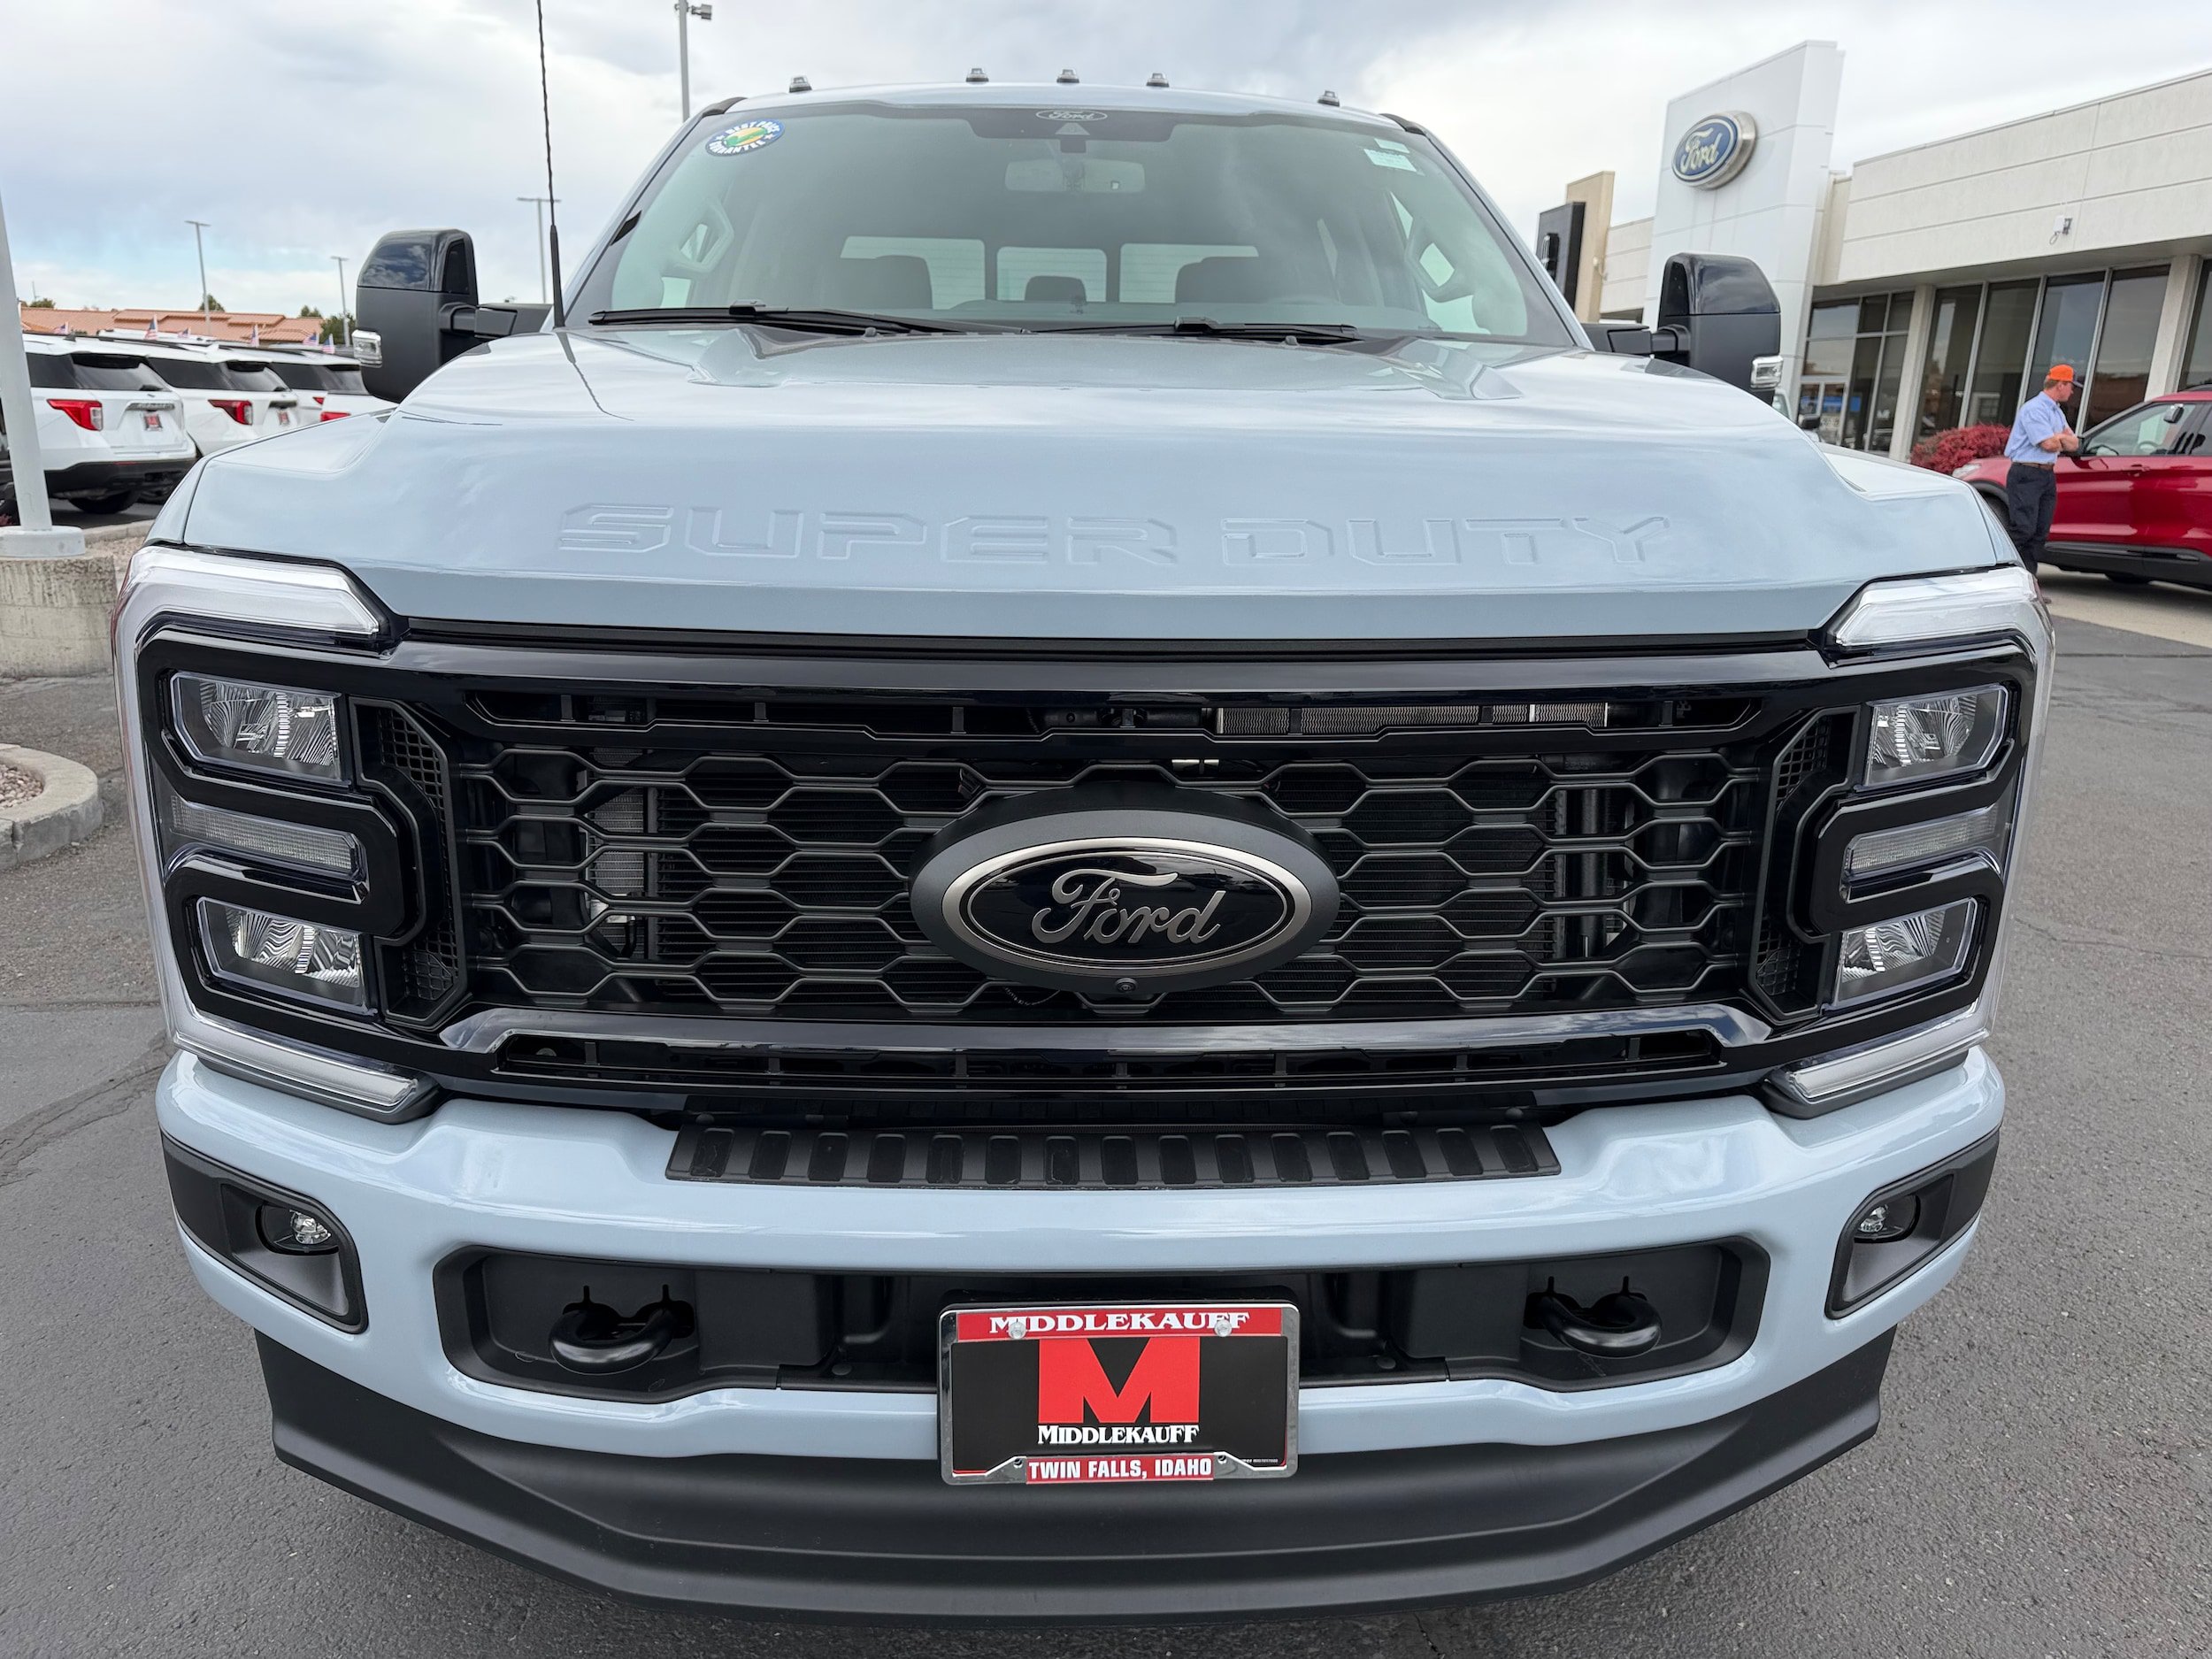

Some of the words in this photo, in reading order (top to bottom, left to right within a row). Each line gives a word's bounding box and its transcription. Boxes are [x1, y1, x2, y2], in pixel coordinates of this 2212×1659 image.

[1048, 111, 1094, 119] Ford
[725, 121, 757, 134] BEST
[1680, 127, 1723, 173] Ford
[558, 503, 1178, 565] SUPER
[1220, 517, 1671, 566] DUTY
[1031, 868, 1226, 944] Ford
[989, 1312, 1250, 1333] MIDDLEKAUFF
[1038, 1336, 1201, 1423] M
[1038, 1425, 1200, 1444] MIDDLEKAUFF
[1029, 1461, 1081, 1479] TWIN
[1087, 1459, 1148, 1479] FALLS,
[1155, 1458, 1212, 1476] IDAHO
